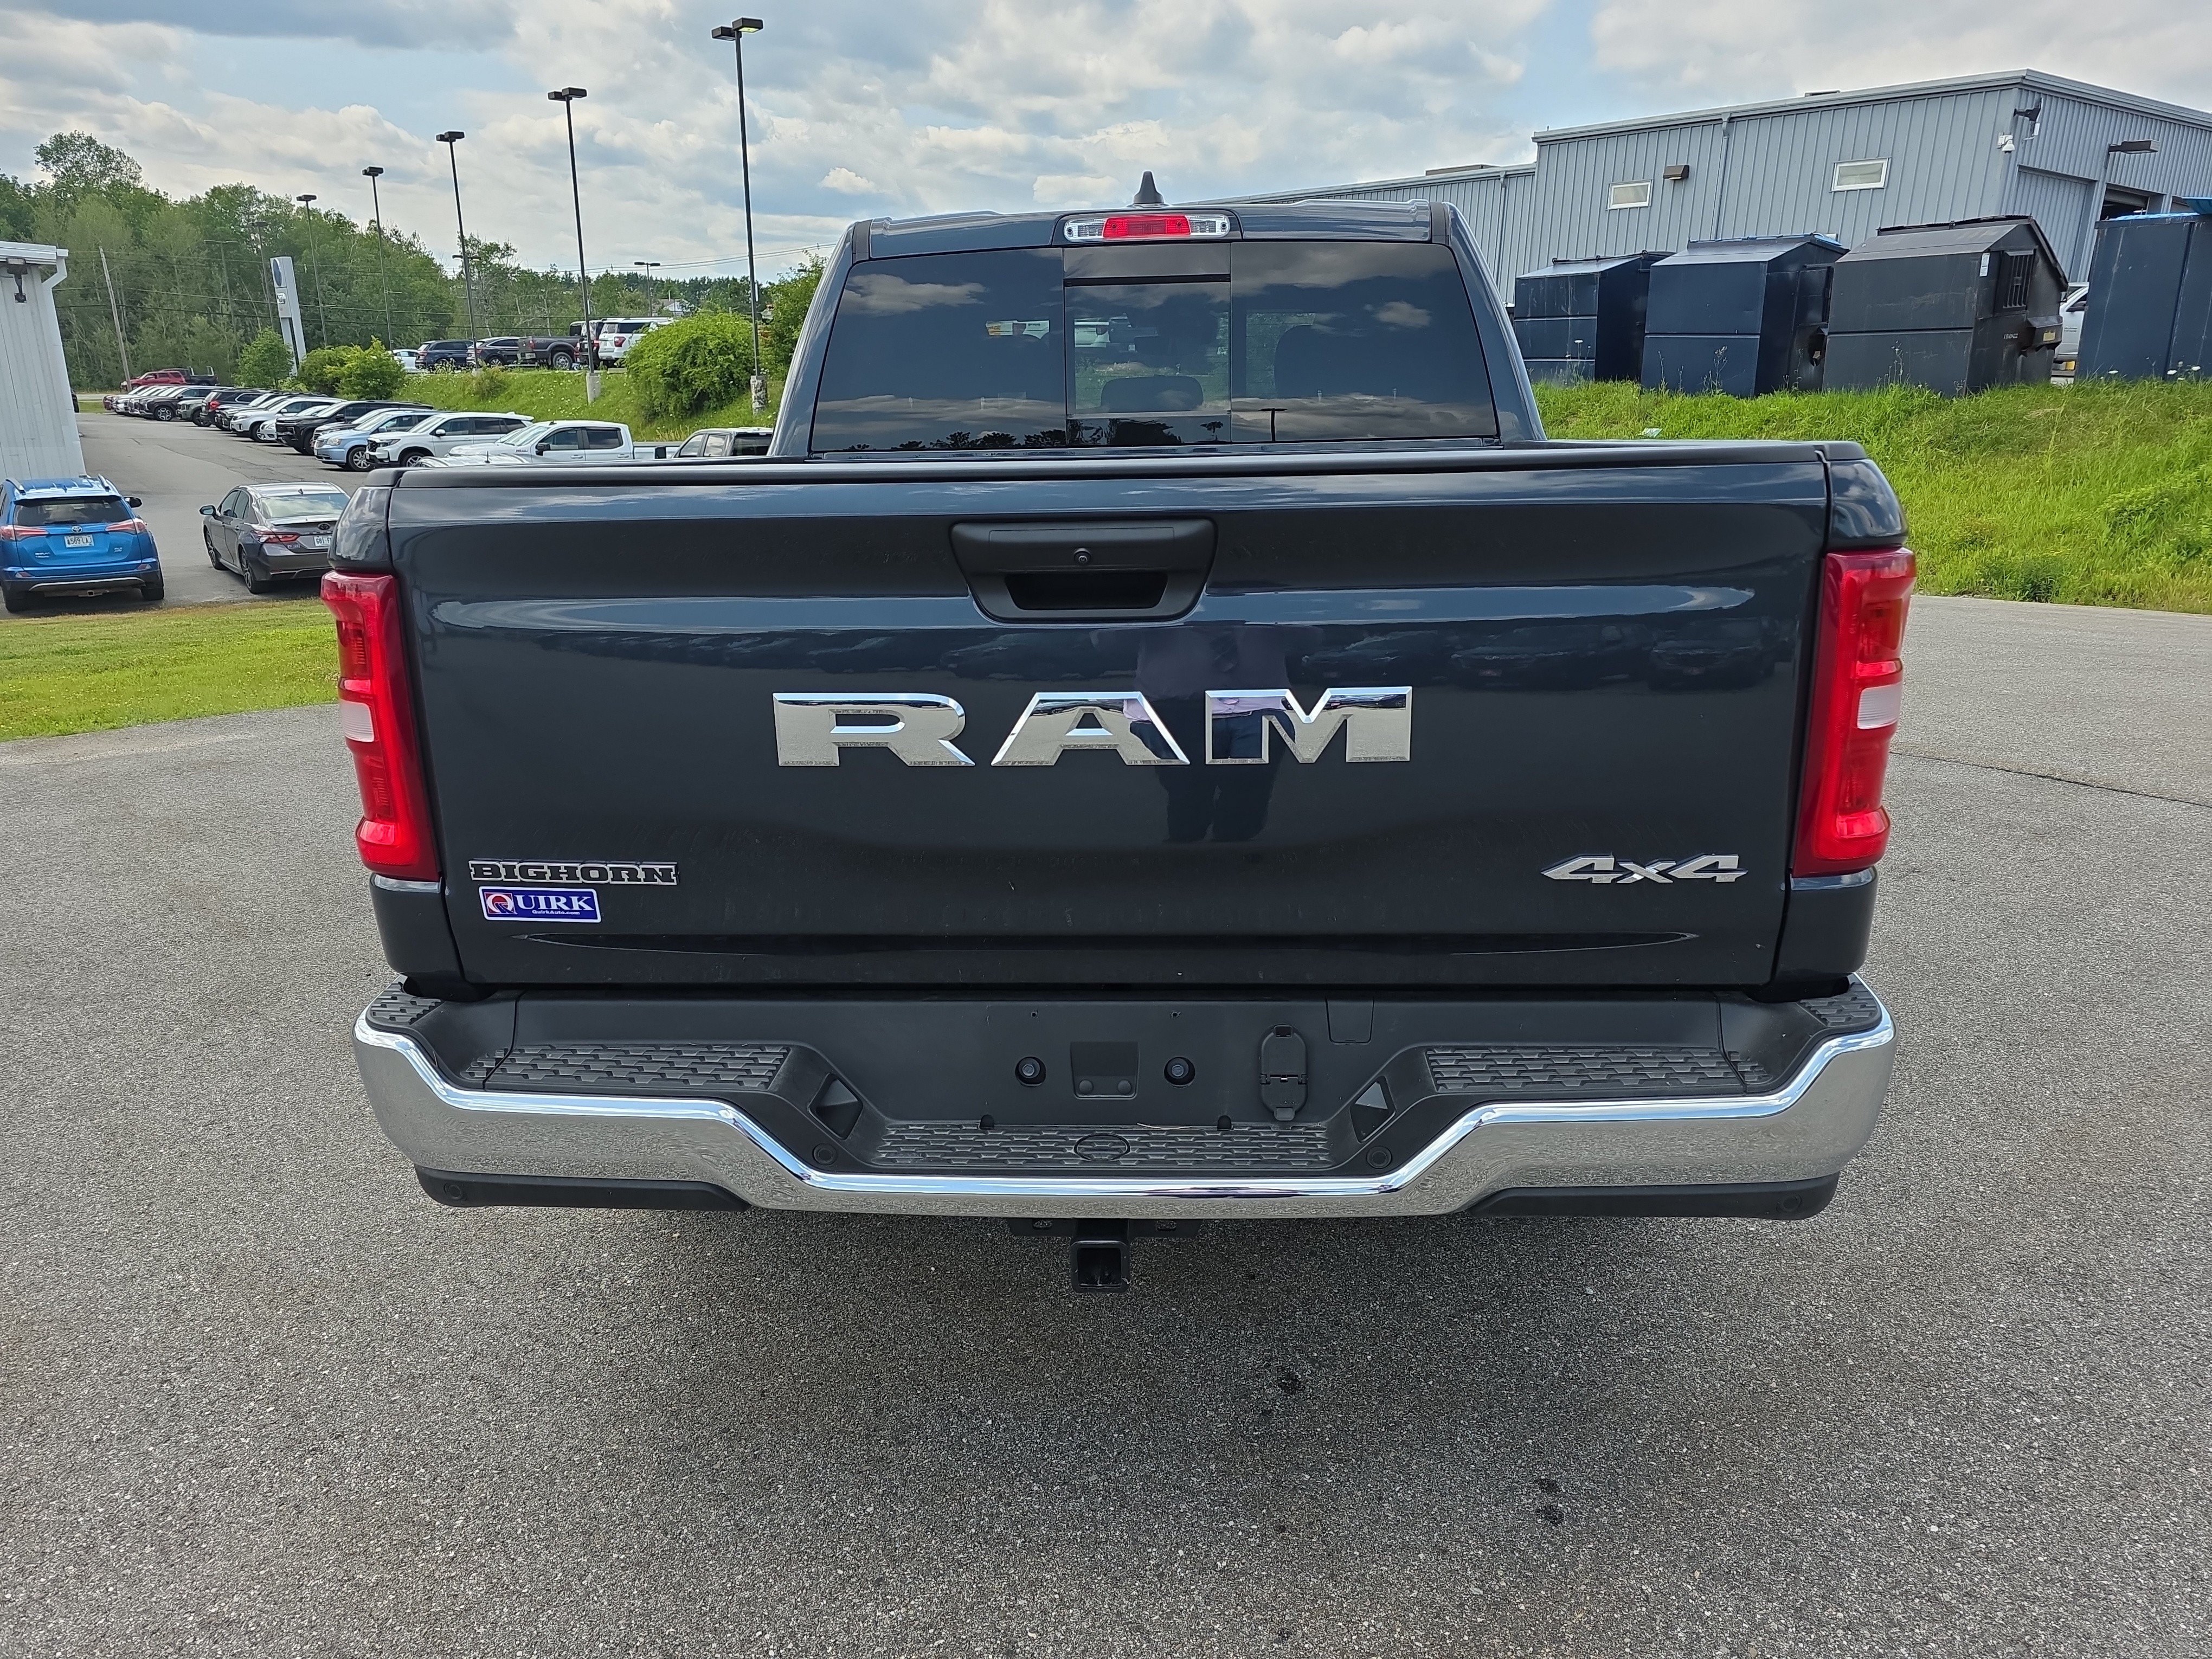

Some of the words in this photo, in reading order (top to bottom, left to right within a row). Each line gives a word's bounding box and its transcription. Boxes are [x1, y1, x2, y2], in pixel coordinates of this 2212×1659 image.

[773, 686, 1412, 766] RAM
[468, 859, 679, 885] BIGHORN
[1540, 854, 1748, 884] 4x4
[487, 893, 595, 914] QUIRK
